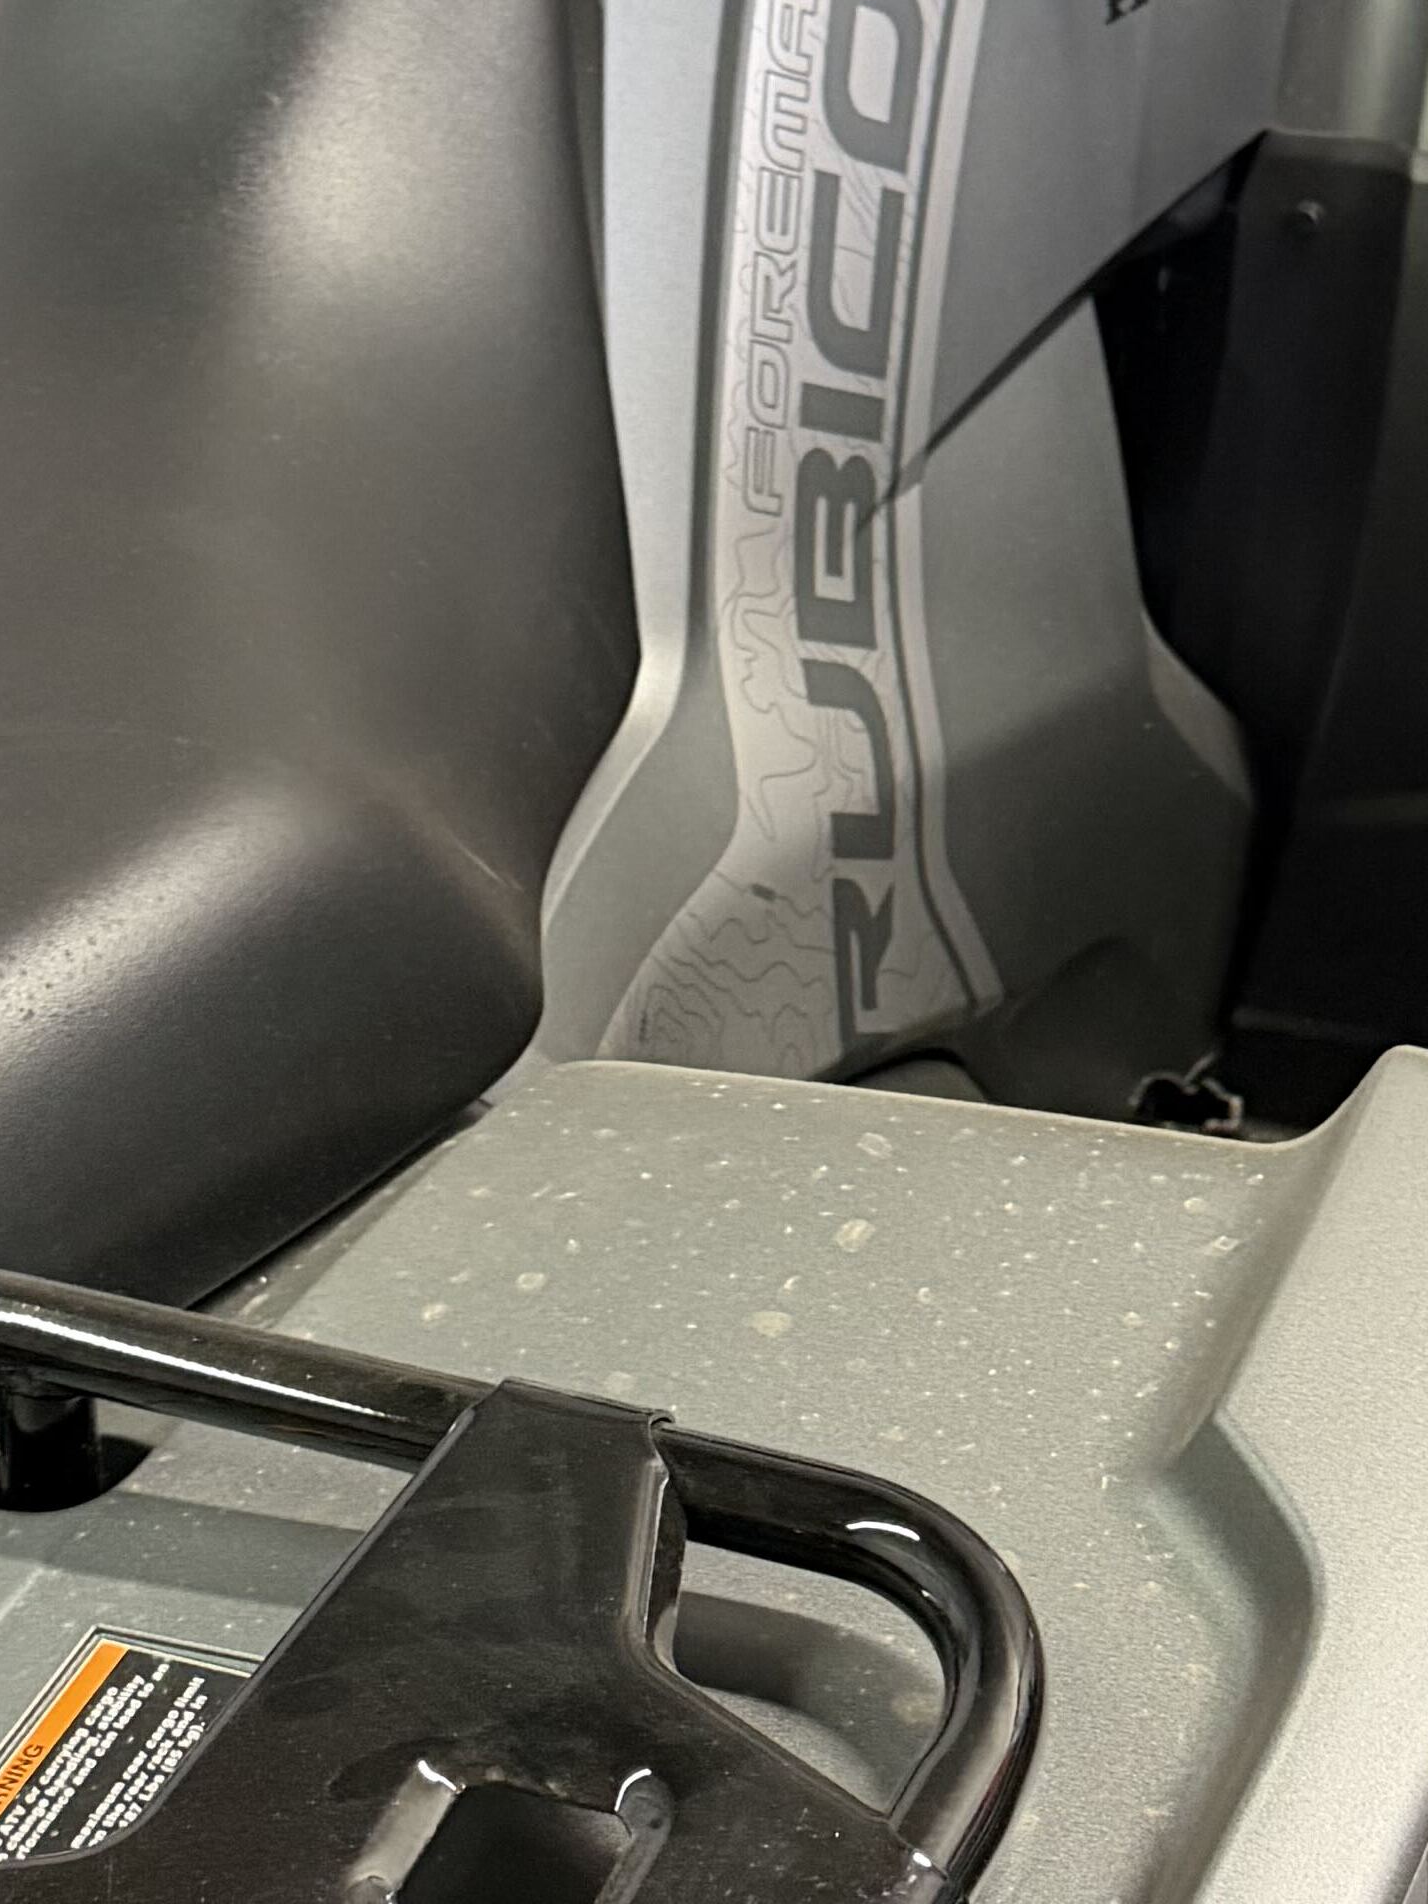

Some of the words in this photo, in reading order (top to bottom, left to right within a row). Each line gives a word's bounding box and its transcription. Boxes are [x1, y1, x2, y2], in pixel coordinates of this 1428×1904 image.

[5, 1798, 52, 1851] change
[96, 1674, 146, 1730] stability
[15, 1787, 75, 1860] rformance
[72, 1758, 97, 1785] and
[94, 1731, 117, 1756] can
[114, 1699, 141, 1728] lead
[36, 1727, 89, 1785] carrying
[83, 1686, 120, 1725] cargo
[69, 1781, 125, 1848] maximum
[121, 1752, 147, 1780] rear
[144, 1709, 182, 1749] cargo
[174, 1676, 203, 1707] limit
[102, 1803, 126, 1827] the
[123, 1772, 149, 1801] rear
[170, 1711, 194, 1736] and
